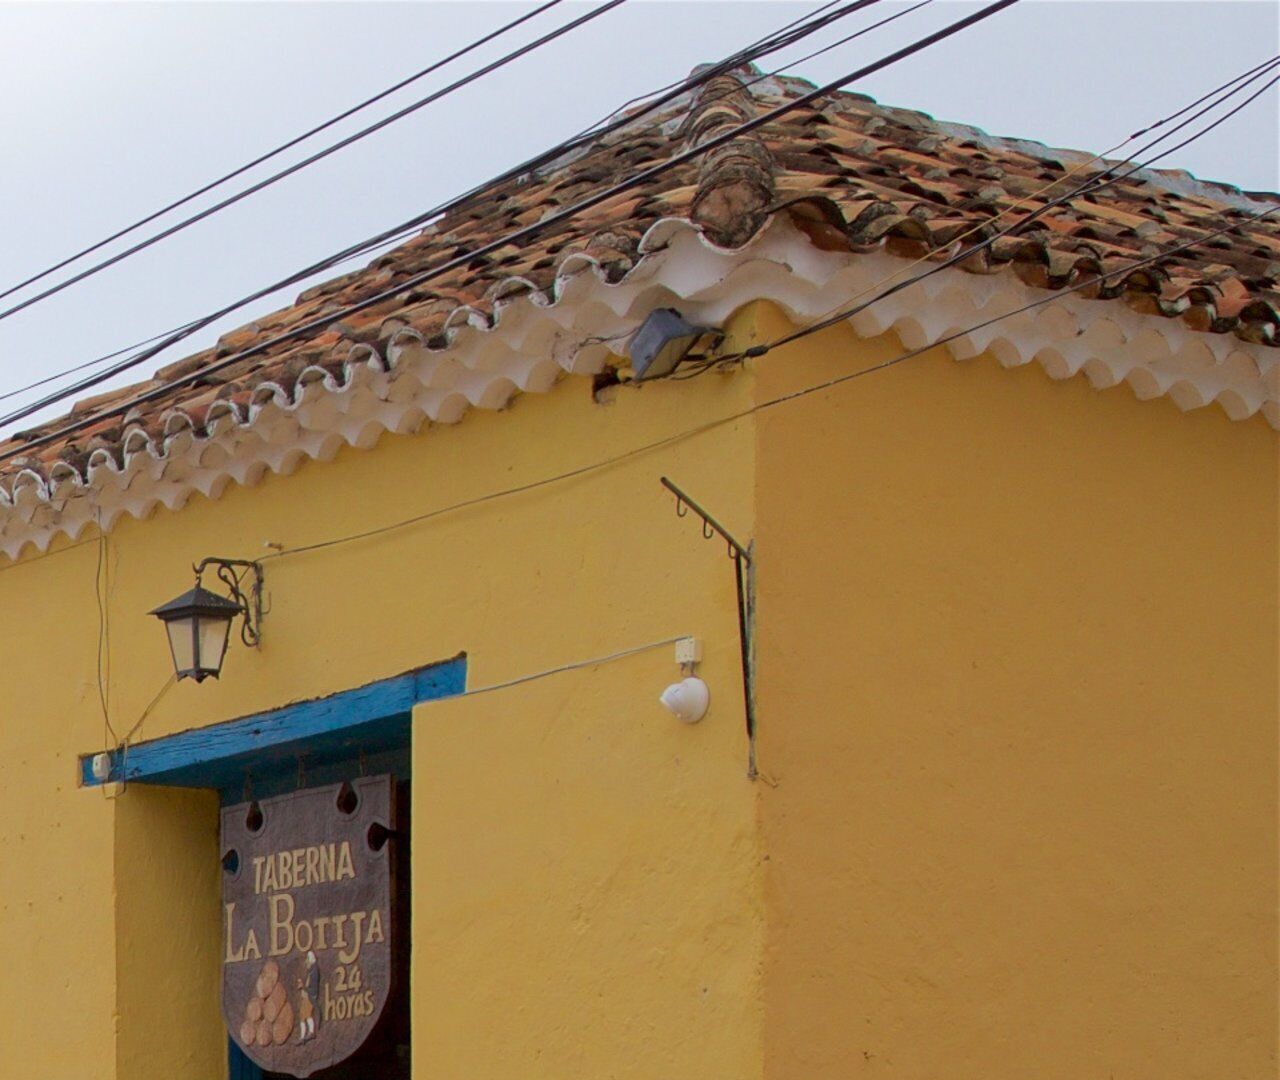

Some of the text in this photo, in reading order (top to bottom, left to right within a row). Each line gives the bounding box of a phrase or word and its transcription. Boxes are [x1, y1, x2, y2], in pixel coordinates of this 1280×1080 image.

[253, 842, 355, 894] TABERNA
[225, 893, 385, 965] LA BOTIJA
[325, 983, 374, 1021] horas
[335, 966, 362, 993] 24
